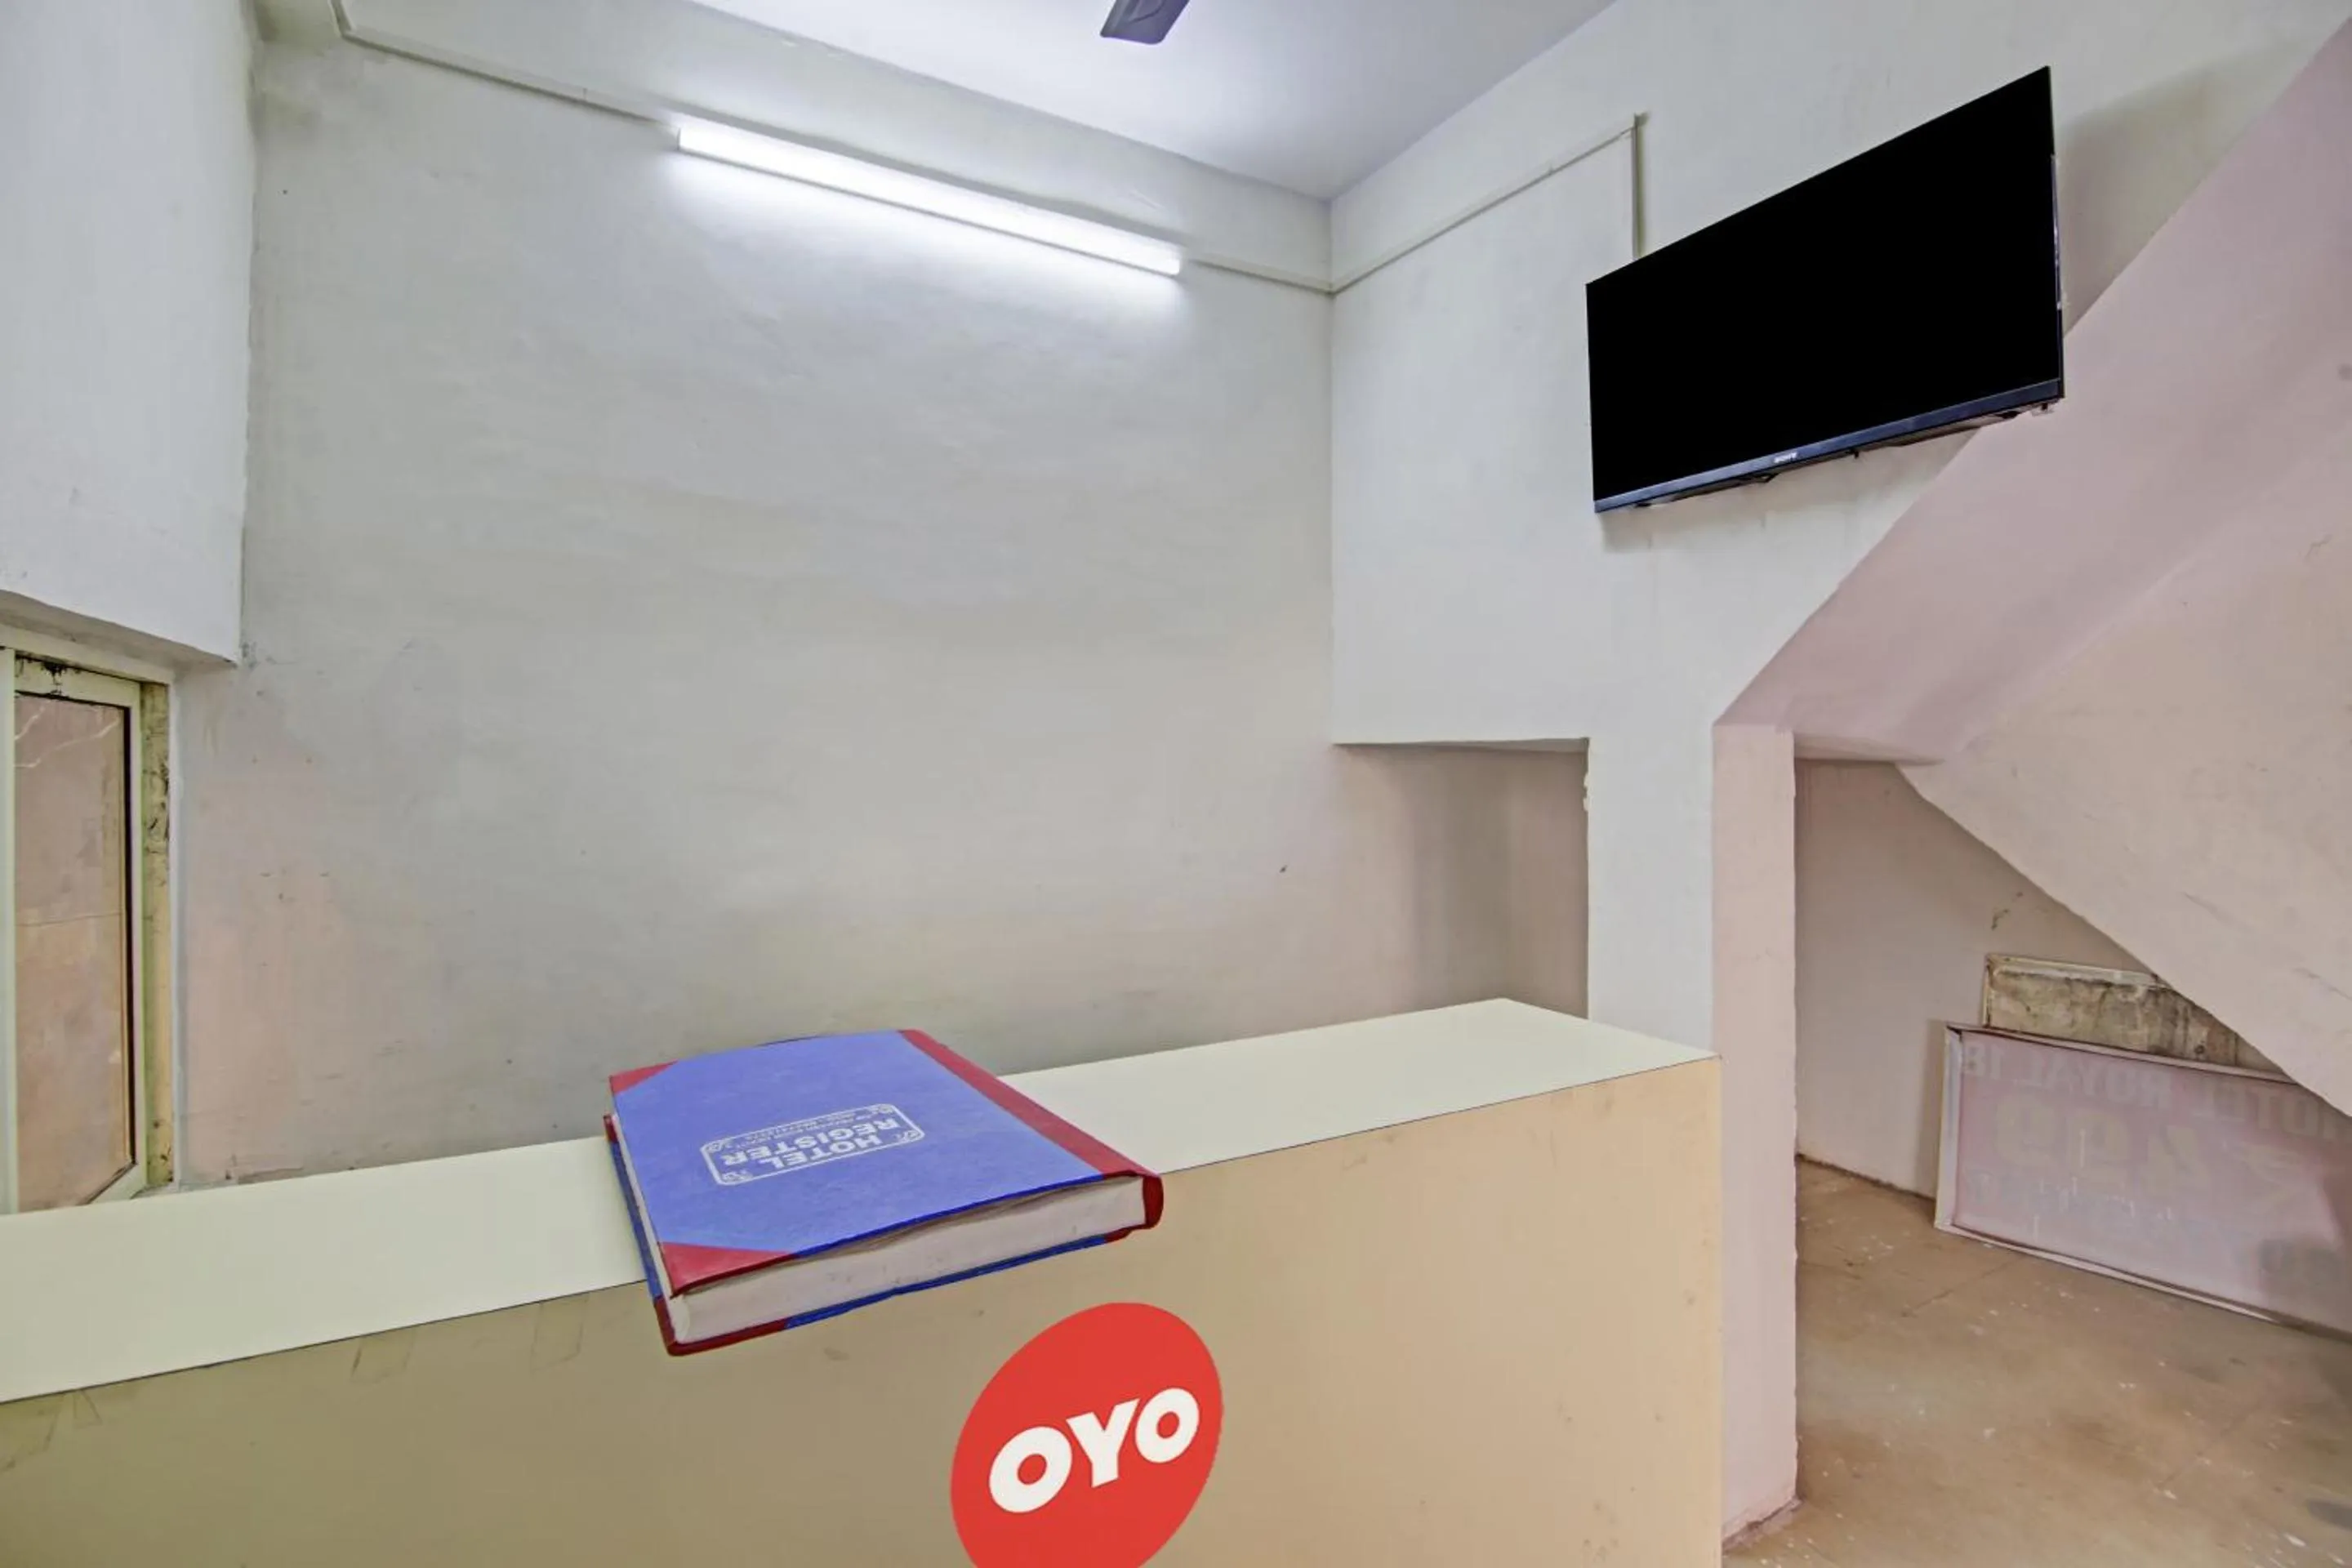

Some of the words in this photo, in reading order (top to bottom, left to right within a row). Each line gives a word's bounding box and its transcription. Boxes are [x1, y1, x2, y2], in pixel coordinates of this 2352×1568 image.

[721, 1118, 901, 1166] REGISTER
[759, 1134, 883, 1169] HOTEL
[988, 1388, 1200, 1513] OYO
